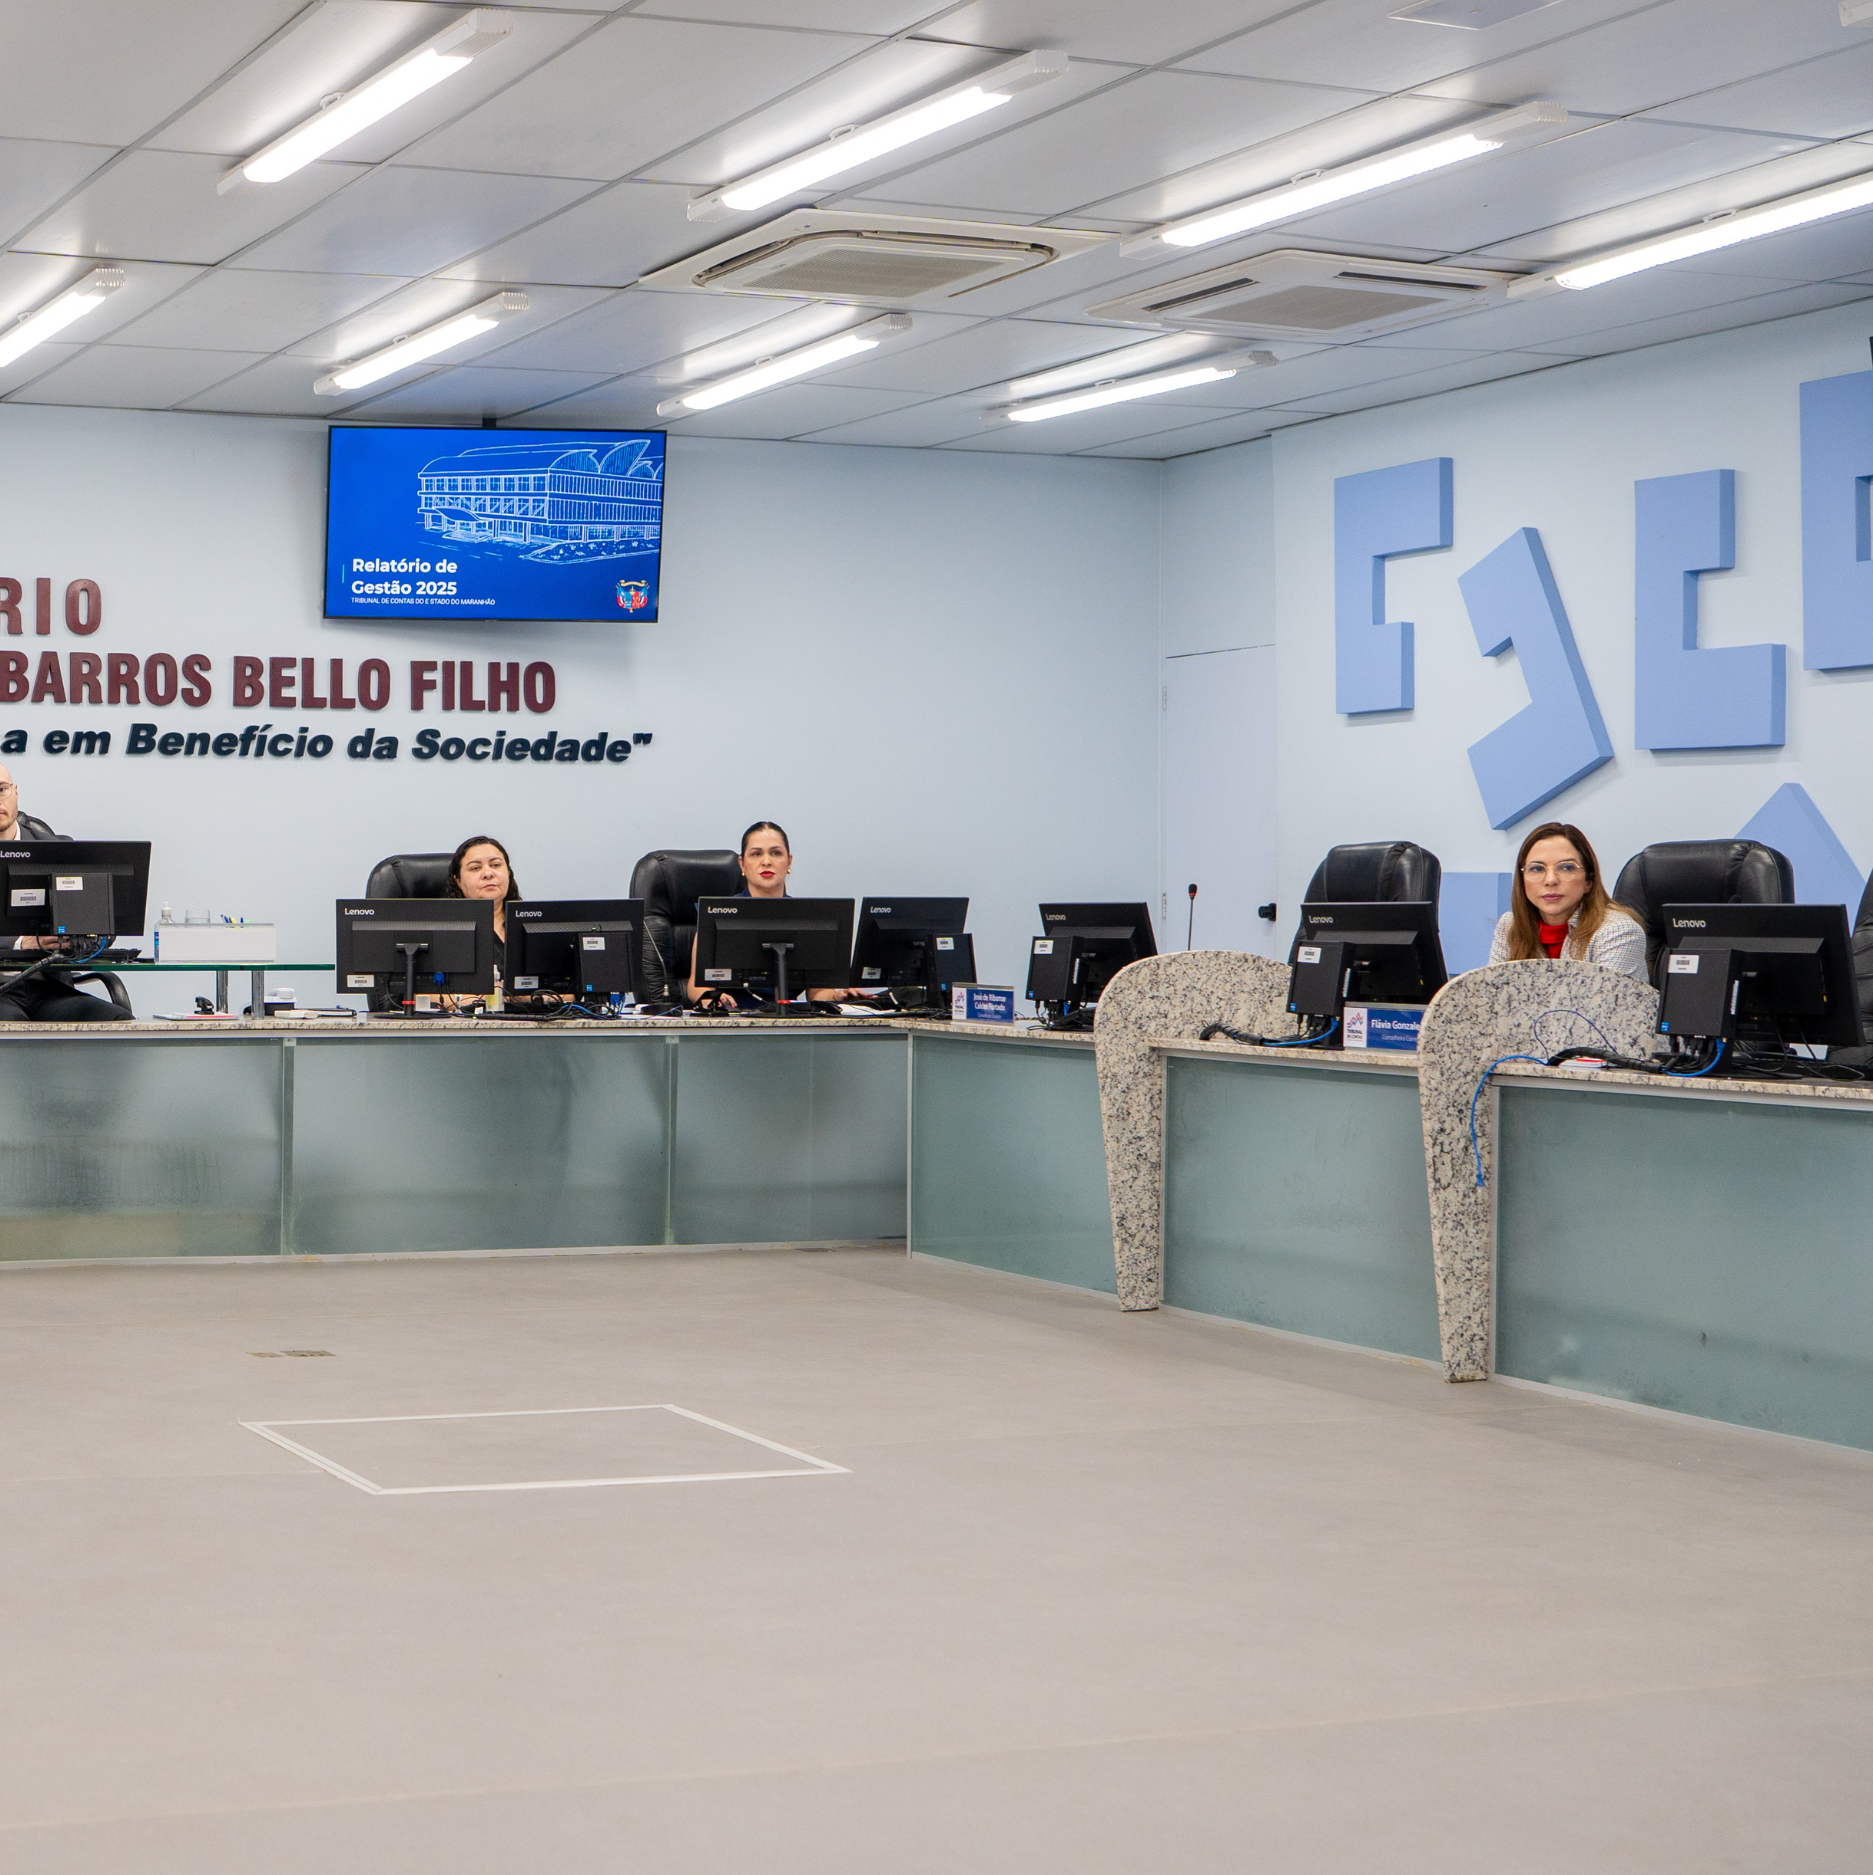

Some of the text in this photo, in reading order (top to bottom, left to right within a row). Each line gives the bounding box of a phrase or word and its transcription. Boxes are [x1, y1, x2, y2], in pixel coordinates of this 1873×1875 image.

[352, 558, 458, 573] Relatório de
[351, 580, 457, 595] Gestão 2025
[233, 655, 392, 711] BELLO
[410, 660, 557, 713] FILHO
[42, 728, 111, 755] em
[125, 722, 334, 758] Benefício
[347, 728, 399, 759] da
[411, 728, 654, 763] Sociedade"
[0, 850, 31, 858] Lenovo
[344, 908, 375, 916] Lenovo
[515, 910, 542, 918] Lenovo
[707, 906, 738, 914] Lenovo
[1308, 915, 1334, 923] Lenovo
[1672, 918, 1707, 928] Lenovo
[1371, 1019, 1421, 1031] Flávia Gonzale
